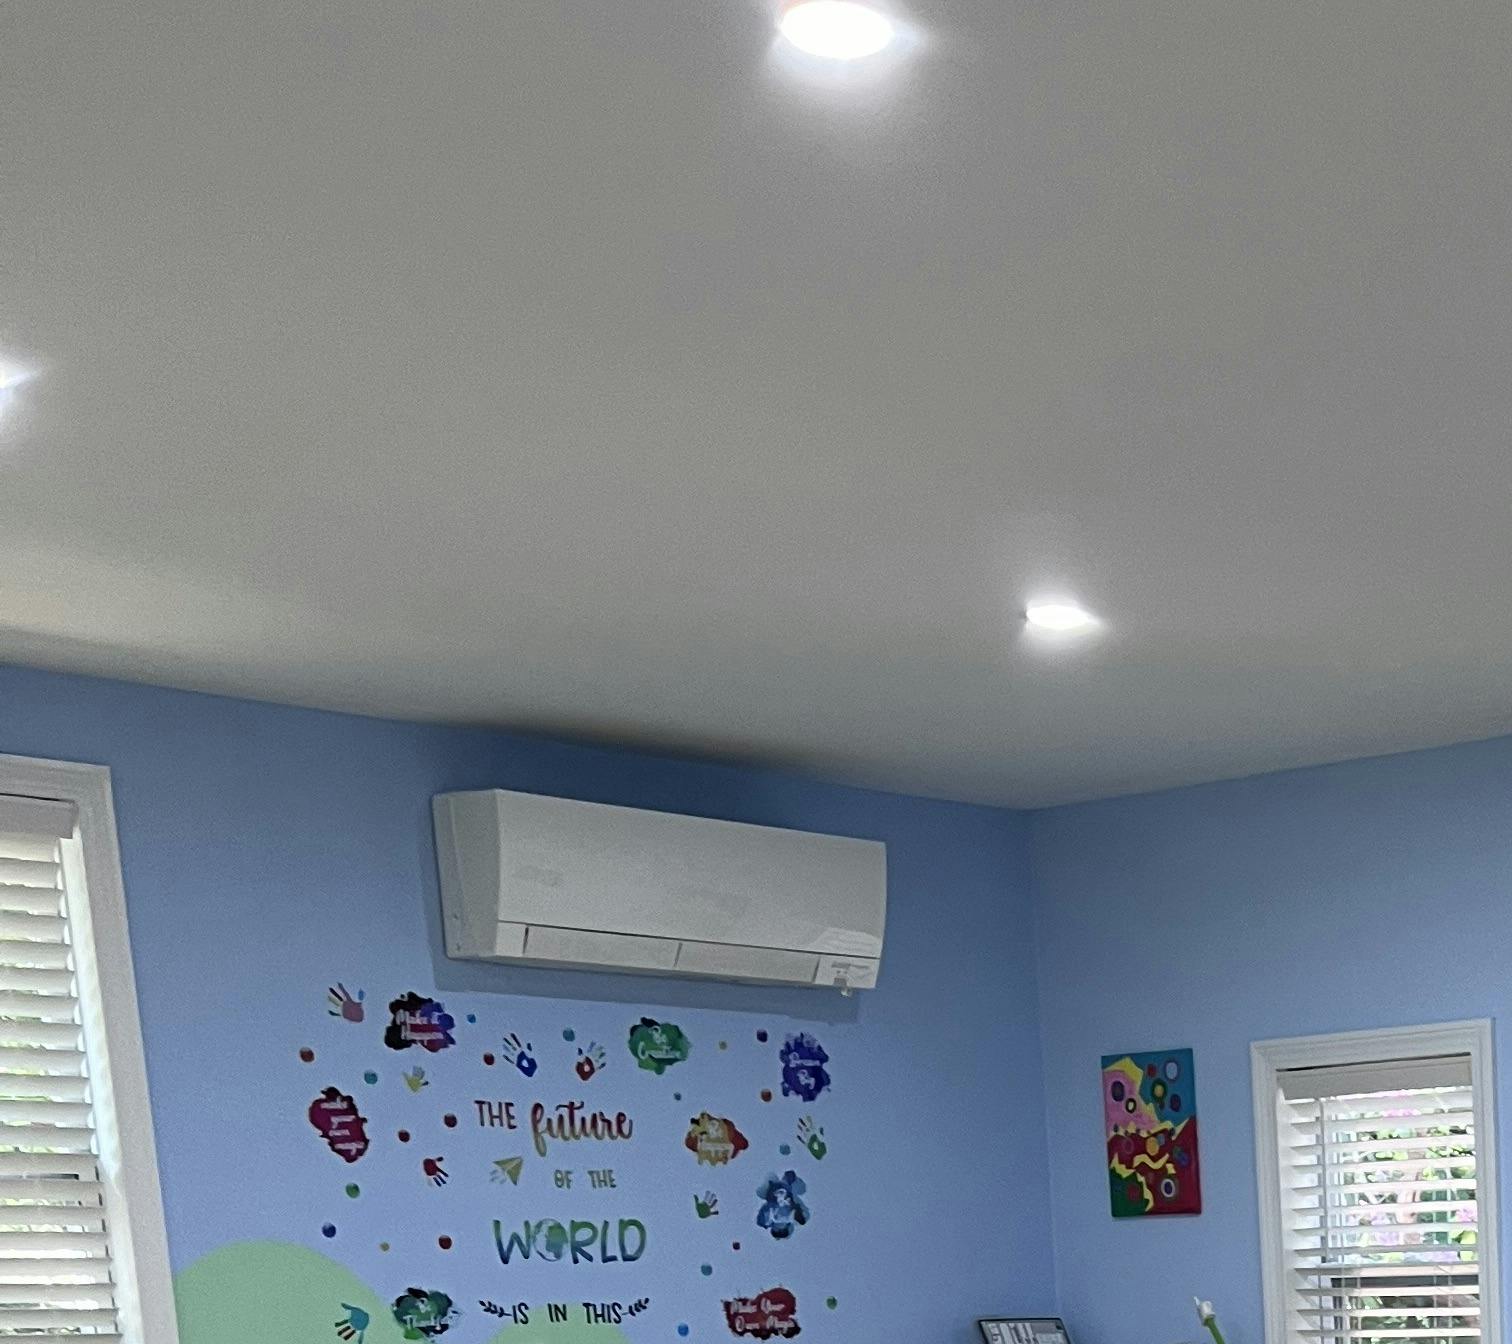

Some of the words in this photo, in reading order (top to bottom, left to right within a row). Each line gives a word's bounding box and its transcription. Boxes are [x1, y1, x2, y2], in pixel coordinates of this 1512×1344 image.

[474, 1100, 517, 1129] THE
[531, 1101, 633, 1157] future
[553, 1169, 573, 1189] OF
[587, 1169, 617, 1189] THE
[493, 1218, 647, 1265] WORLD
[512, 1302, 530, 1325] IS
[547, 1303, 567, 1323] IN
[582, 1302, 622, 1324] THIS
